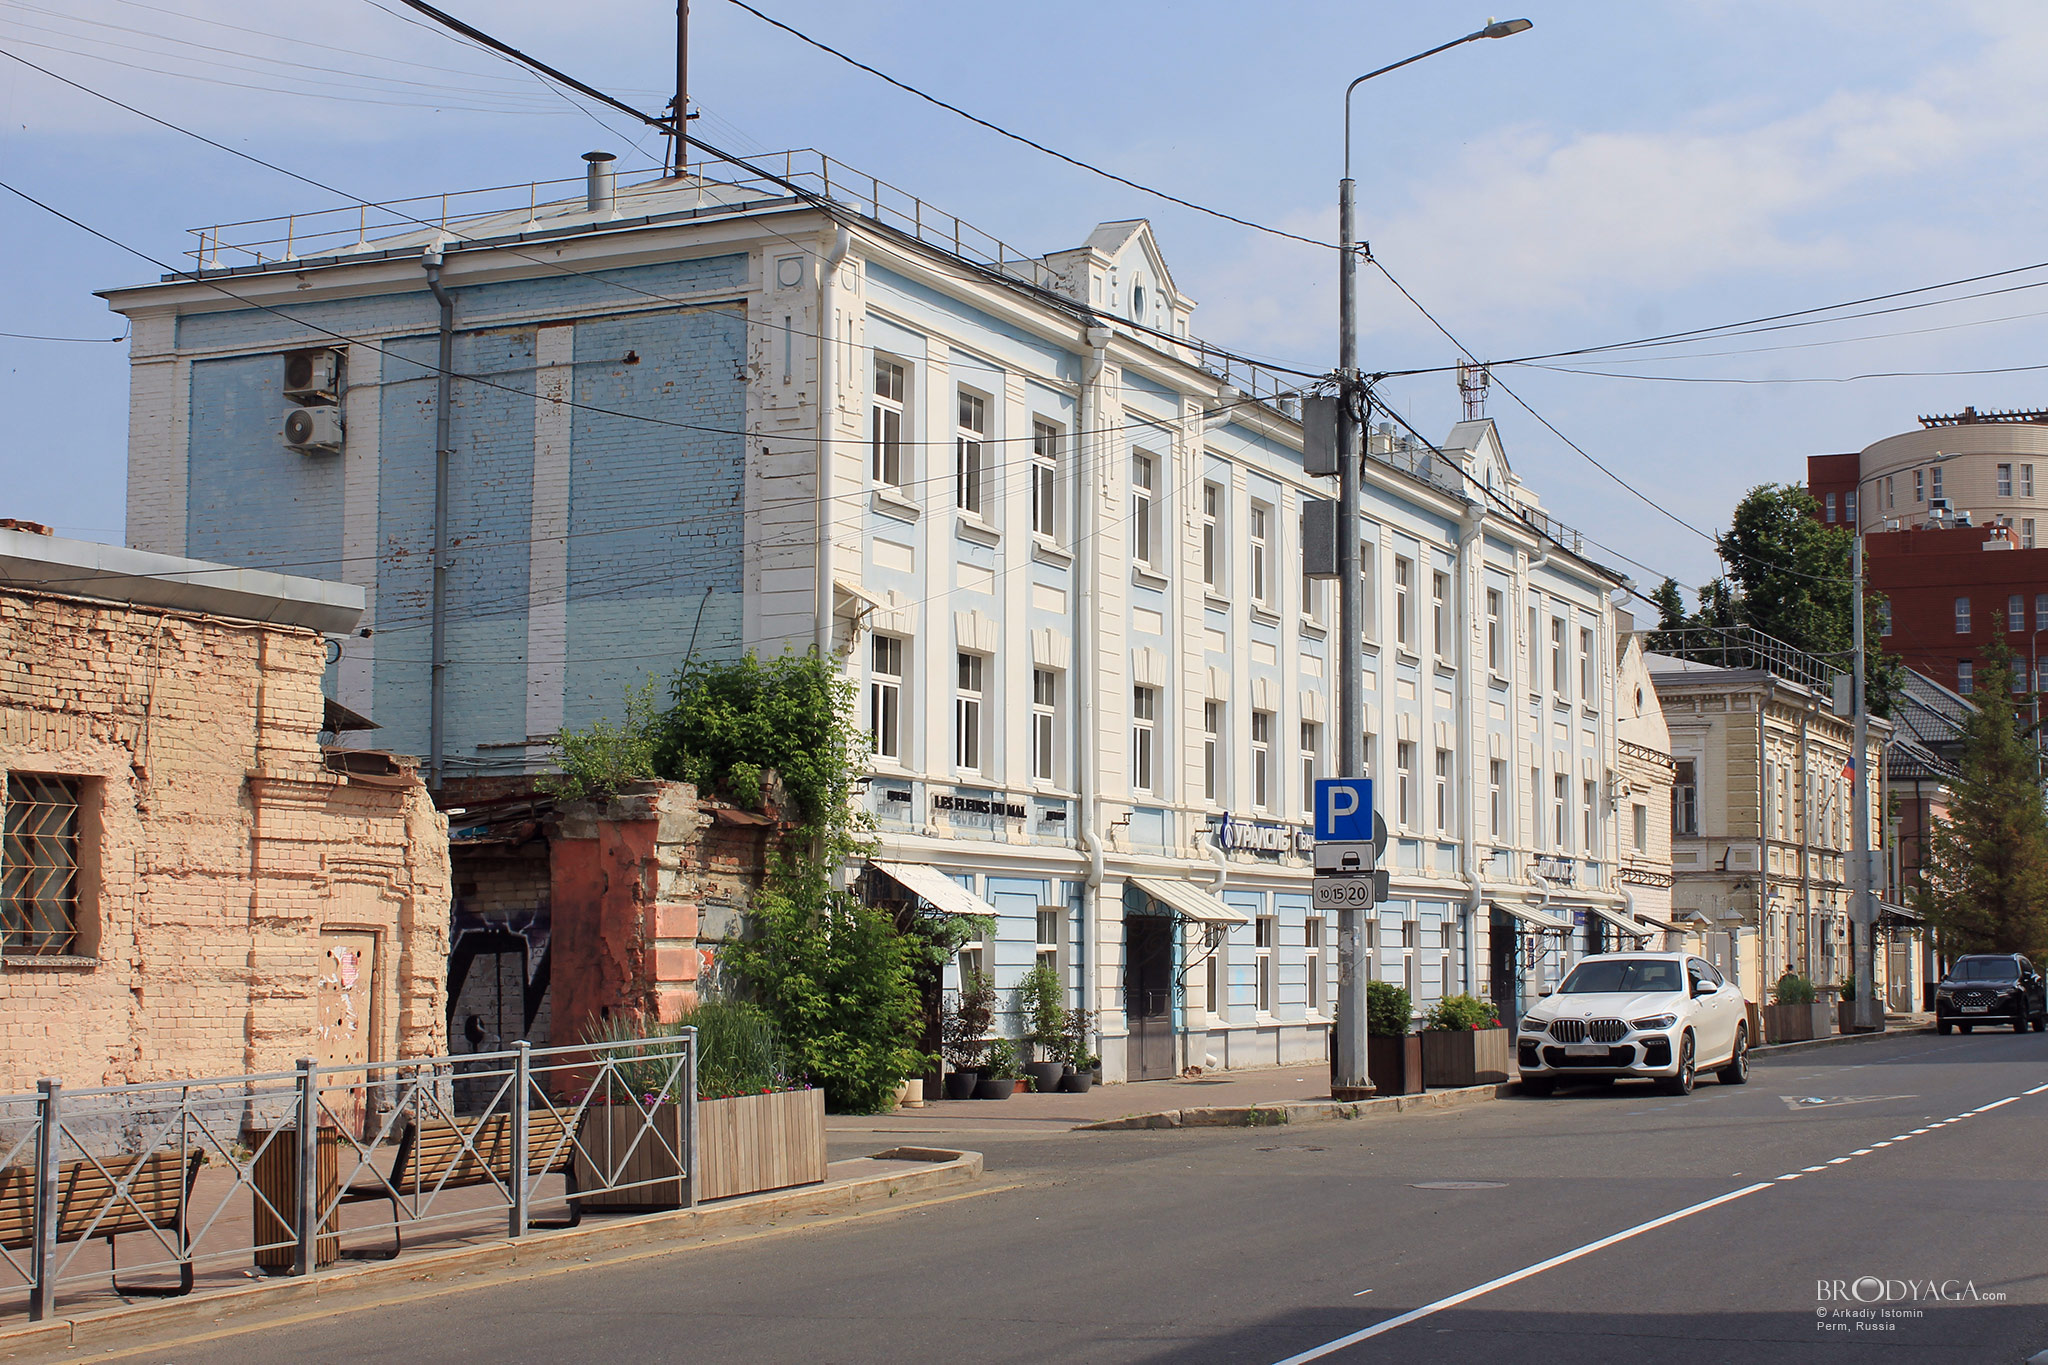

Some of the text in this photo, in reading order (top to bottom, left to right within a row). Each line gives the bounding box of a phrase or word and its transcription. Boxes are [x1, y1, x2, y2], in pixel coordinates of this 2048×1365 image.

[934, 795, 1027, 818] LES FLEURS DU MAL
[1327, 786, 1359, 834] P
[1231, 823, 1291, 851] УРАЛСИБ
[1320, 887, 1366, 900] 10 15 20
